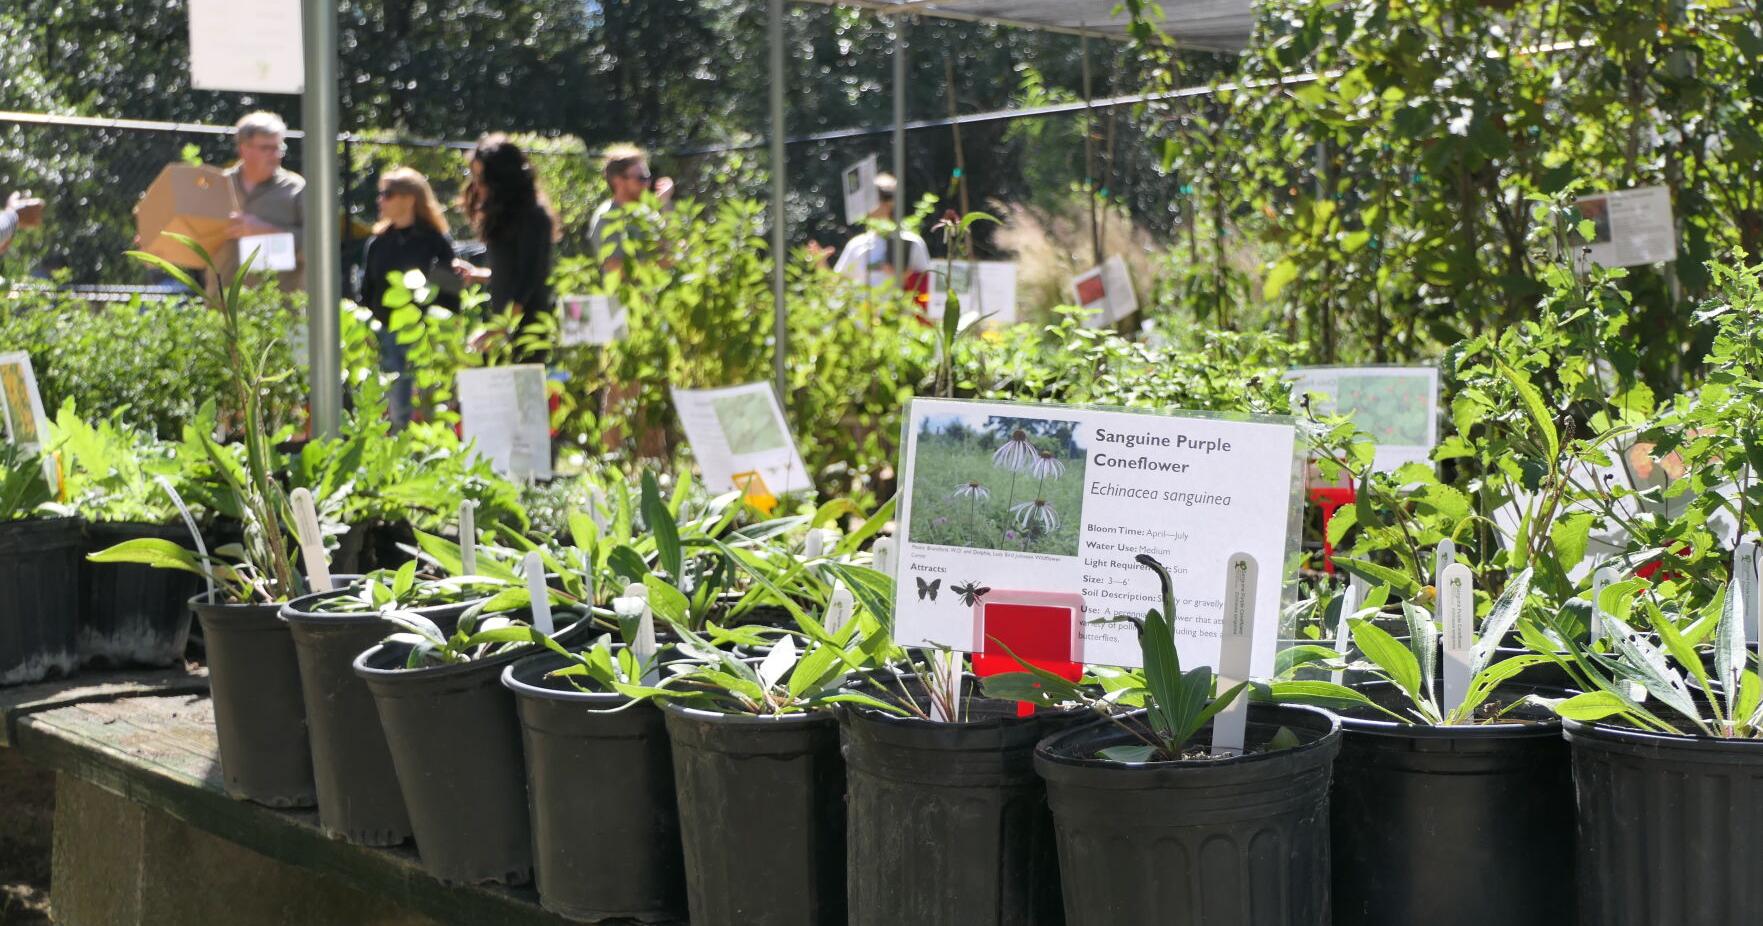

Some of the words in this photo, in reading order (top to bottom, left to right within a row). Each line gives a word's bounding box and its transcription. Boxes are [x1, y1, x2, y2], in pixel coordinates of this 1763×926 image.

[1095, 428, 1171, 448] Sanguine
[1176, 434, 1232, 454] Purple
[1093, 453, 1190, 473] Coneflower
[1090, 481, 1158, 500] Echinacea
[1163, 489, 1232, 507] sanguinea
[1087, 523, 1117, 534] Bloom
[1119, 526, 1145, 536] Time:
[1085, 540, 1115, 550] Water
[1117, 543, 1137, 553] Use:
[1139, 545, 1171, 556] Medium
[910, 562, 947, 573] Attracts:
[1084, 558, 1108, 569] Light
[1173, 566, 1188, 574] Sun
[1082, 574, 1104, 584] Size:
[1081, 588, 1099, 597] Soil
[1101, 590, 1156, 602] Description:
[1080, 605, 1100, 614] Use:
[1104, 607, 1111, 615] A
[1193, 599, 1224, 609] gravelly
[1195, 616, 1211, 624] that
[1199, 628, 1218, 638] bees
